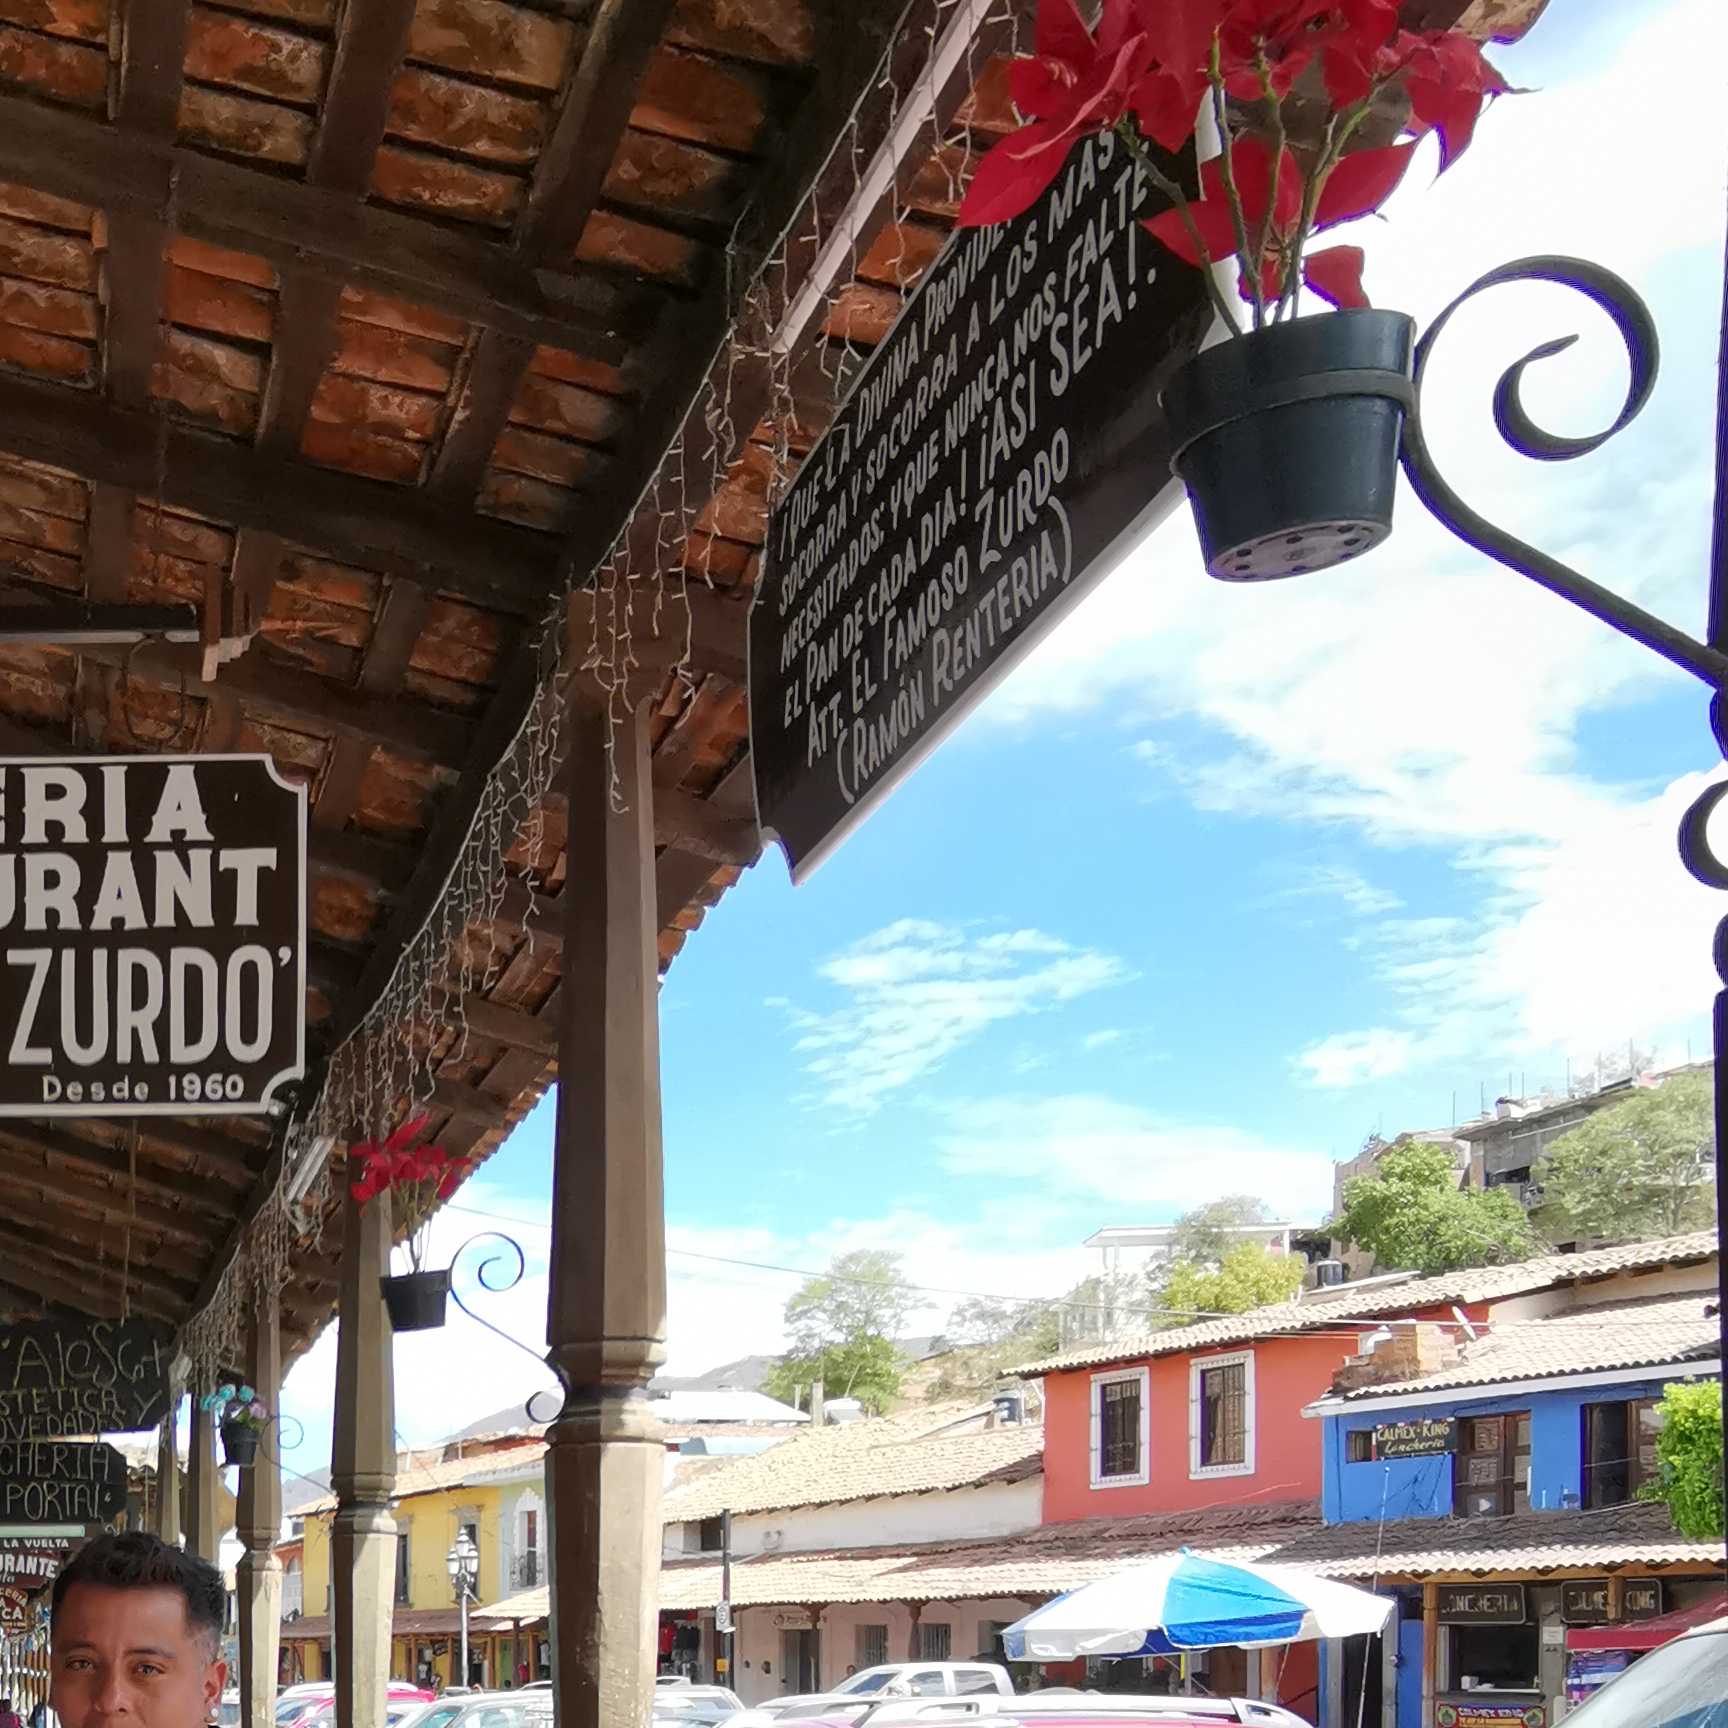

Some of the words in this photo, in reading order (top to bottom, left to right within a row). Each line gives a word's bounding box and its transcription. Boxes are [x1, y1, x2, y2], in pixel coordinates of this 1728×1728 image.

[779, 489, 847, 617] SOCORRA
[851, 467, 862, 516] Y
[866, 333, 957, 494] SOCORRA
[966, 301, 980, 355] A
[990, 219, 1037, 325] LOS
[1048, 128, 1114, 243] MAS
[945, 337, 1009, 457] NUNCA
[1014, 271, 1056, 367] NOS
[1064, 140, 1150, 302] FALTE
[825, 423, 851, 492] LA
[856, 321, 919, 449] DIVINA
[784, 679, 803, 729] EL
[805, 627, 839, 704] PAN
[842, 597, 864, 658] DE
[868, 537, 916, 626] CADA
[836, 669, 924, 804] (RAMÓN
[932, 495, 1072, 707] RENTERIA)
[852, 649, 877, 714] EL
[883, 545, 968, 681] FAMOSO
[974, 427, 1069, 573] ZURDO
[42, 1074, 150, 1102] Desde
[168, 1073, 245, 1100] 1960
[133, 1389, 162, 1426] Y
[3, 1539, 19, 1549] LA
[24, 1538, 69, 1549] VUELTA
